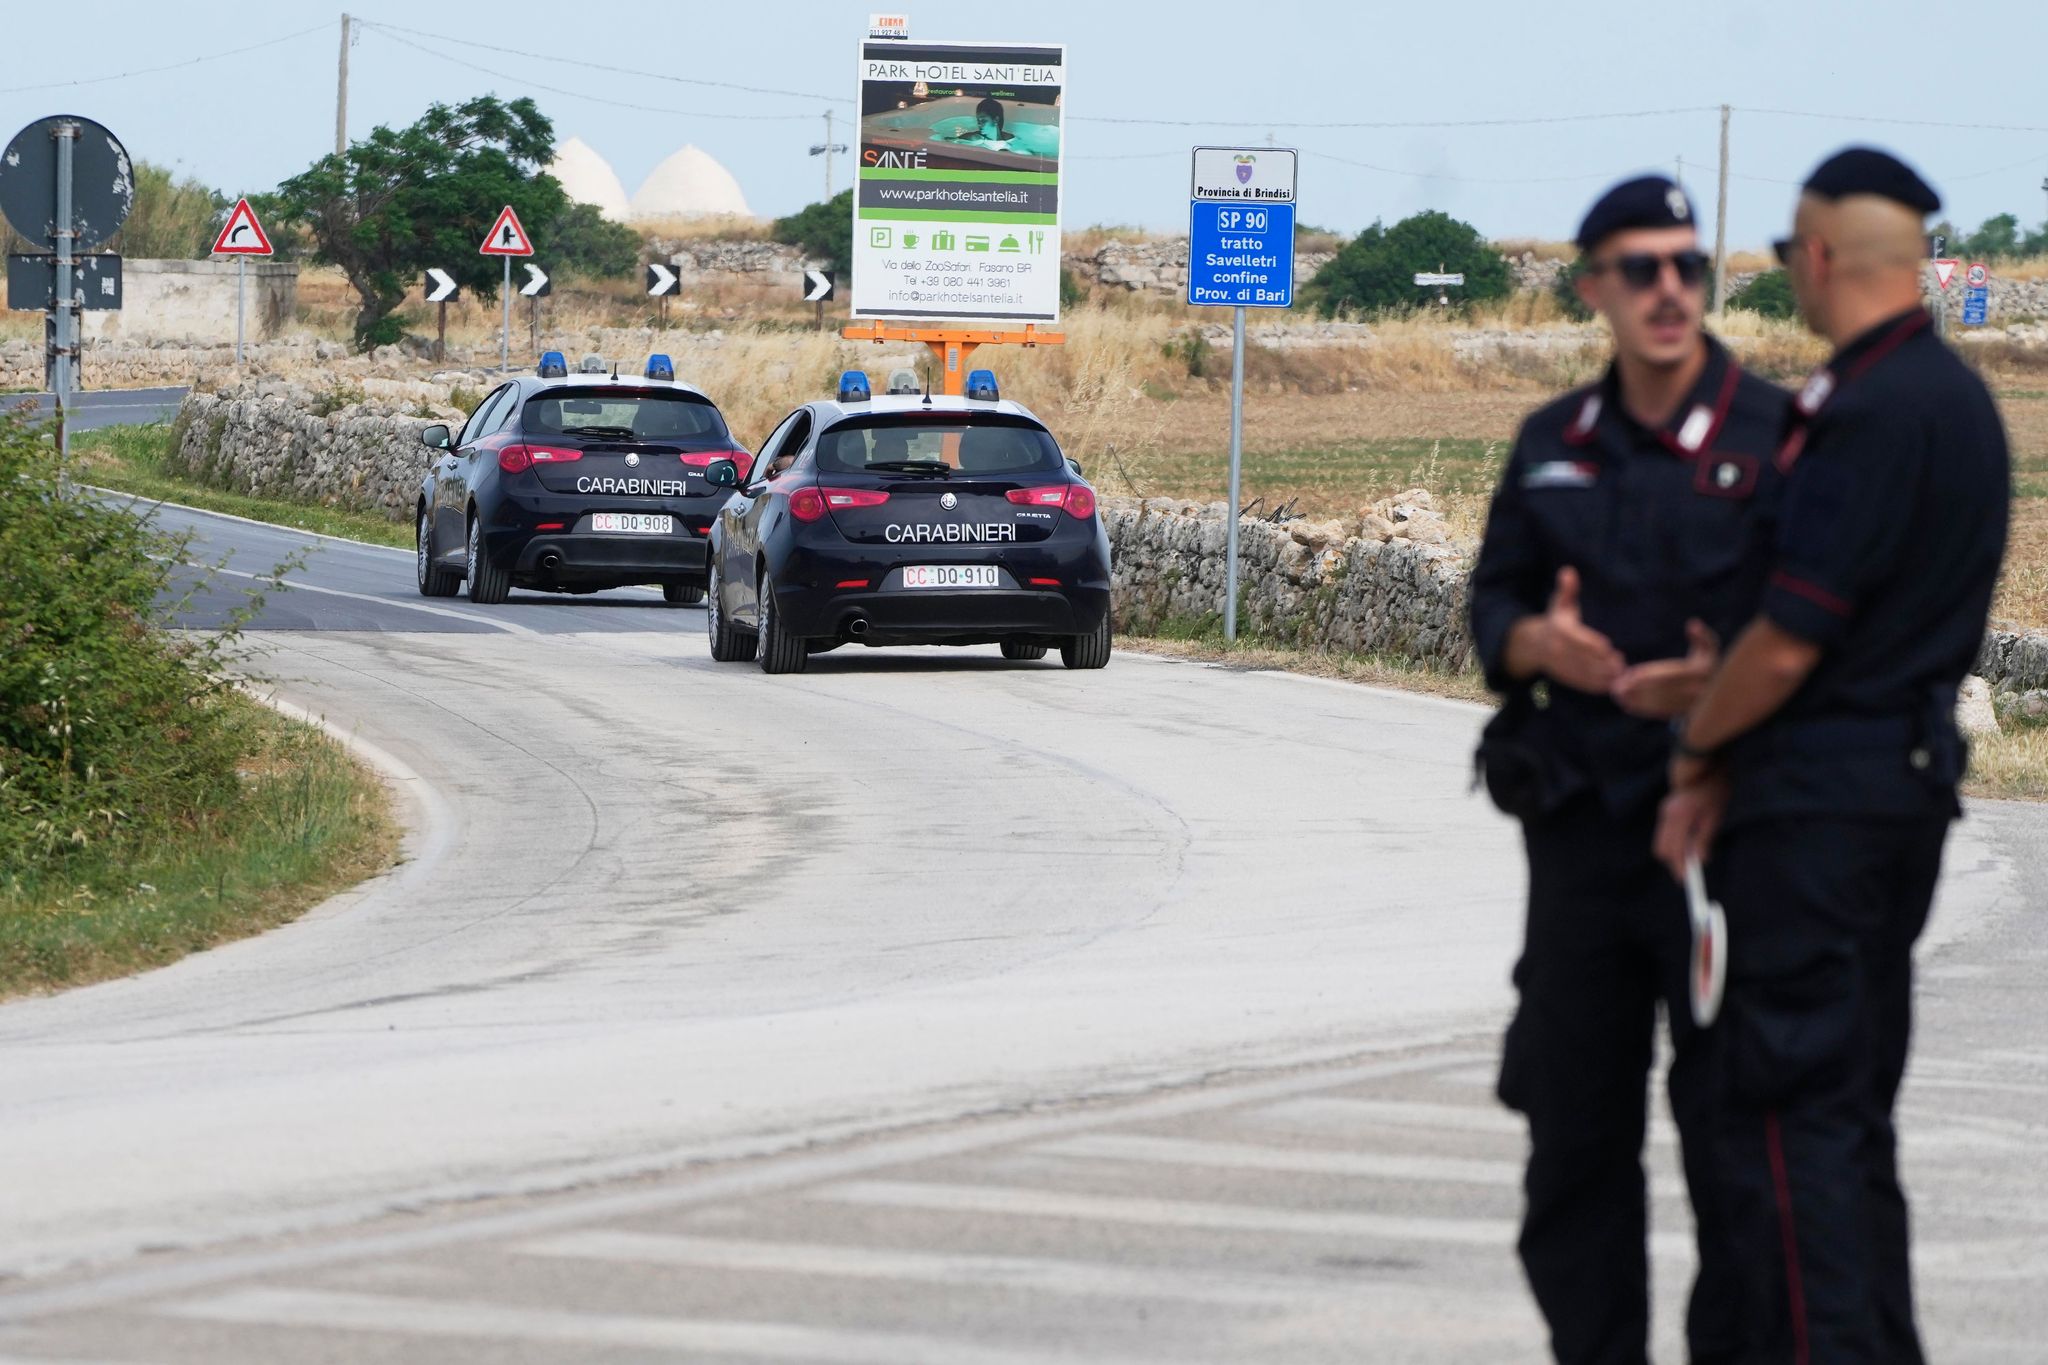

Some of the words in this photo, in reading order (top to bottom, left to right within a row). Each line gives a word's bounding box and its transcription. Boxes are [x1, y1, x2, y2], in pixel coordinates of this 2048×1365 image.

[869, 63, 908, 78] PARK
[916, 65, 967, 80] HOTEL
[973, 67, 1055, 82] SANT'ELIA
[863, 148, 928, 169] SANTÉ
[879, 188, 1029, 203] www.parkhotelsantelia.it
[1197, 186, 1240, 198] Provincia
[1243, 188, 1252, 198] di
[1255, 188, 1290, 199] Brindisi
[1220, 211, 1241, 229] SP
[1245, 212, 1266, 229] 90
[1221, 237, 1263, 250] tratto
[882, 260, 897, 270] Via
[900, 260, 921, 271] dello
[979, 262, 1014, 273] Fasano
[1017, 263, 1032, 273] BR
[1206, 254, 1277, 268] Savelletri
[921, 276, 939, 286] +39
[943, 276, 963, 287] 080
[967, 277, 984, 287] 441
[1213, 271, 1268, 284] confine
[888, 289, 1023, 304] info@parkhotelsantelia.it
[1195, 287, 1231, 300] Prov.
[1237, 288, 1250, 301] di
[1256, 289, 1285, 302] Bari
[577, 476, 686, 496] CARABINIERI
[595, 514, 612, 529] CC
[621, 516, 638, 530] DQ
[644, 516, 670, 531] 908
[885, 523, 1016, 543] CARABINIERI
[906, 567, 927, 585] CC
[937, 567, 958, 584] DQ
[965, 567, 995, 585] 910
